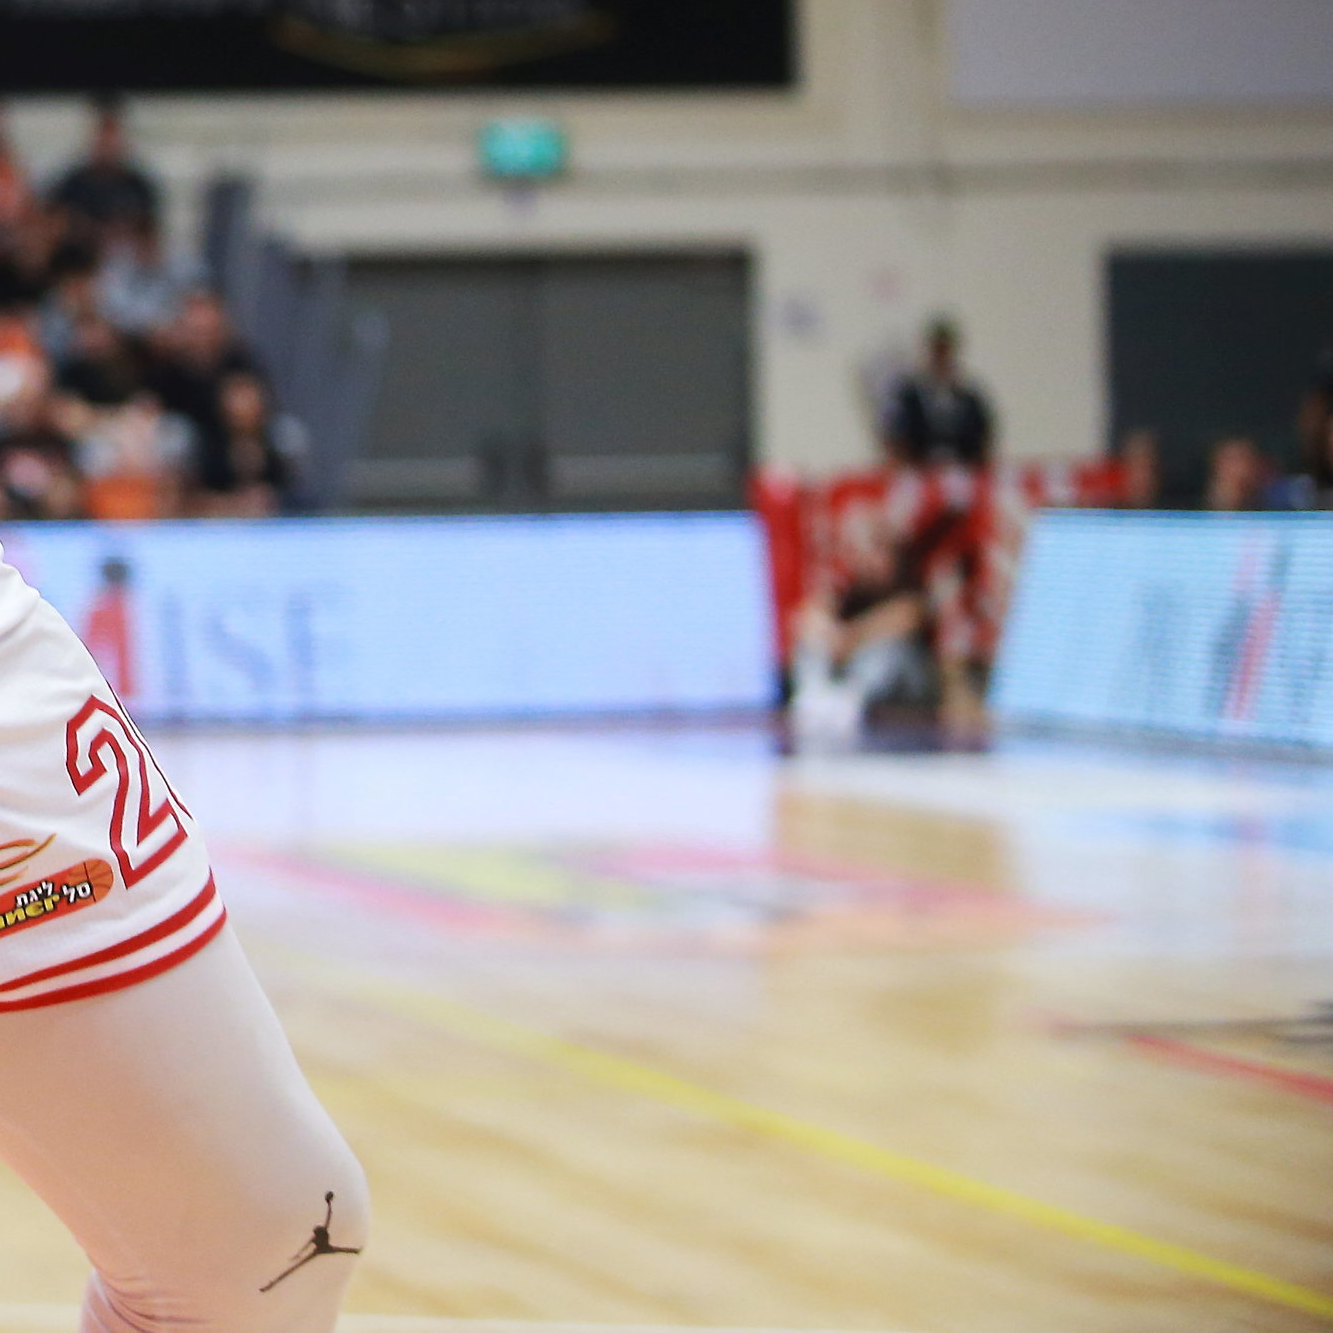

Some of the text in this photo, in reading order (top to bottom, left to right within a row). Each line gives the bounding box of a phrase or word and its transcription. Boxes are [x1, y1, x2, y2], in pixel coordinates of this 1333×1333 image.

[65, 694, 191, 890] 2
[16, 880, 55, 907] ליגת
[61, 881, 92, 904] סל
